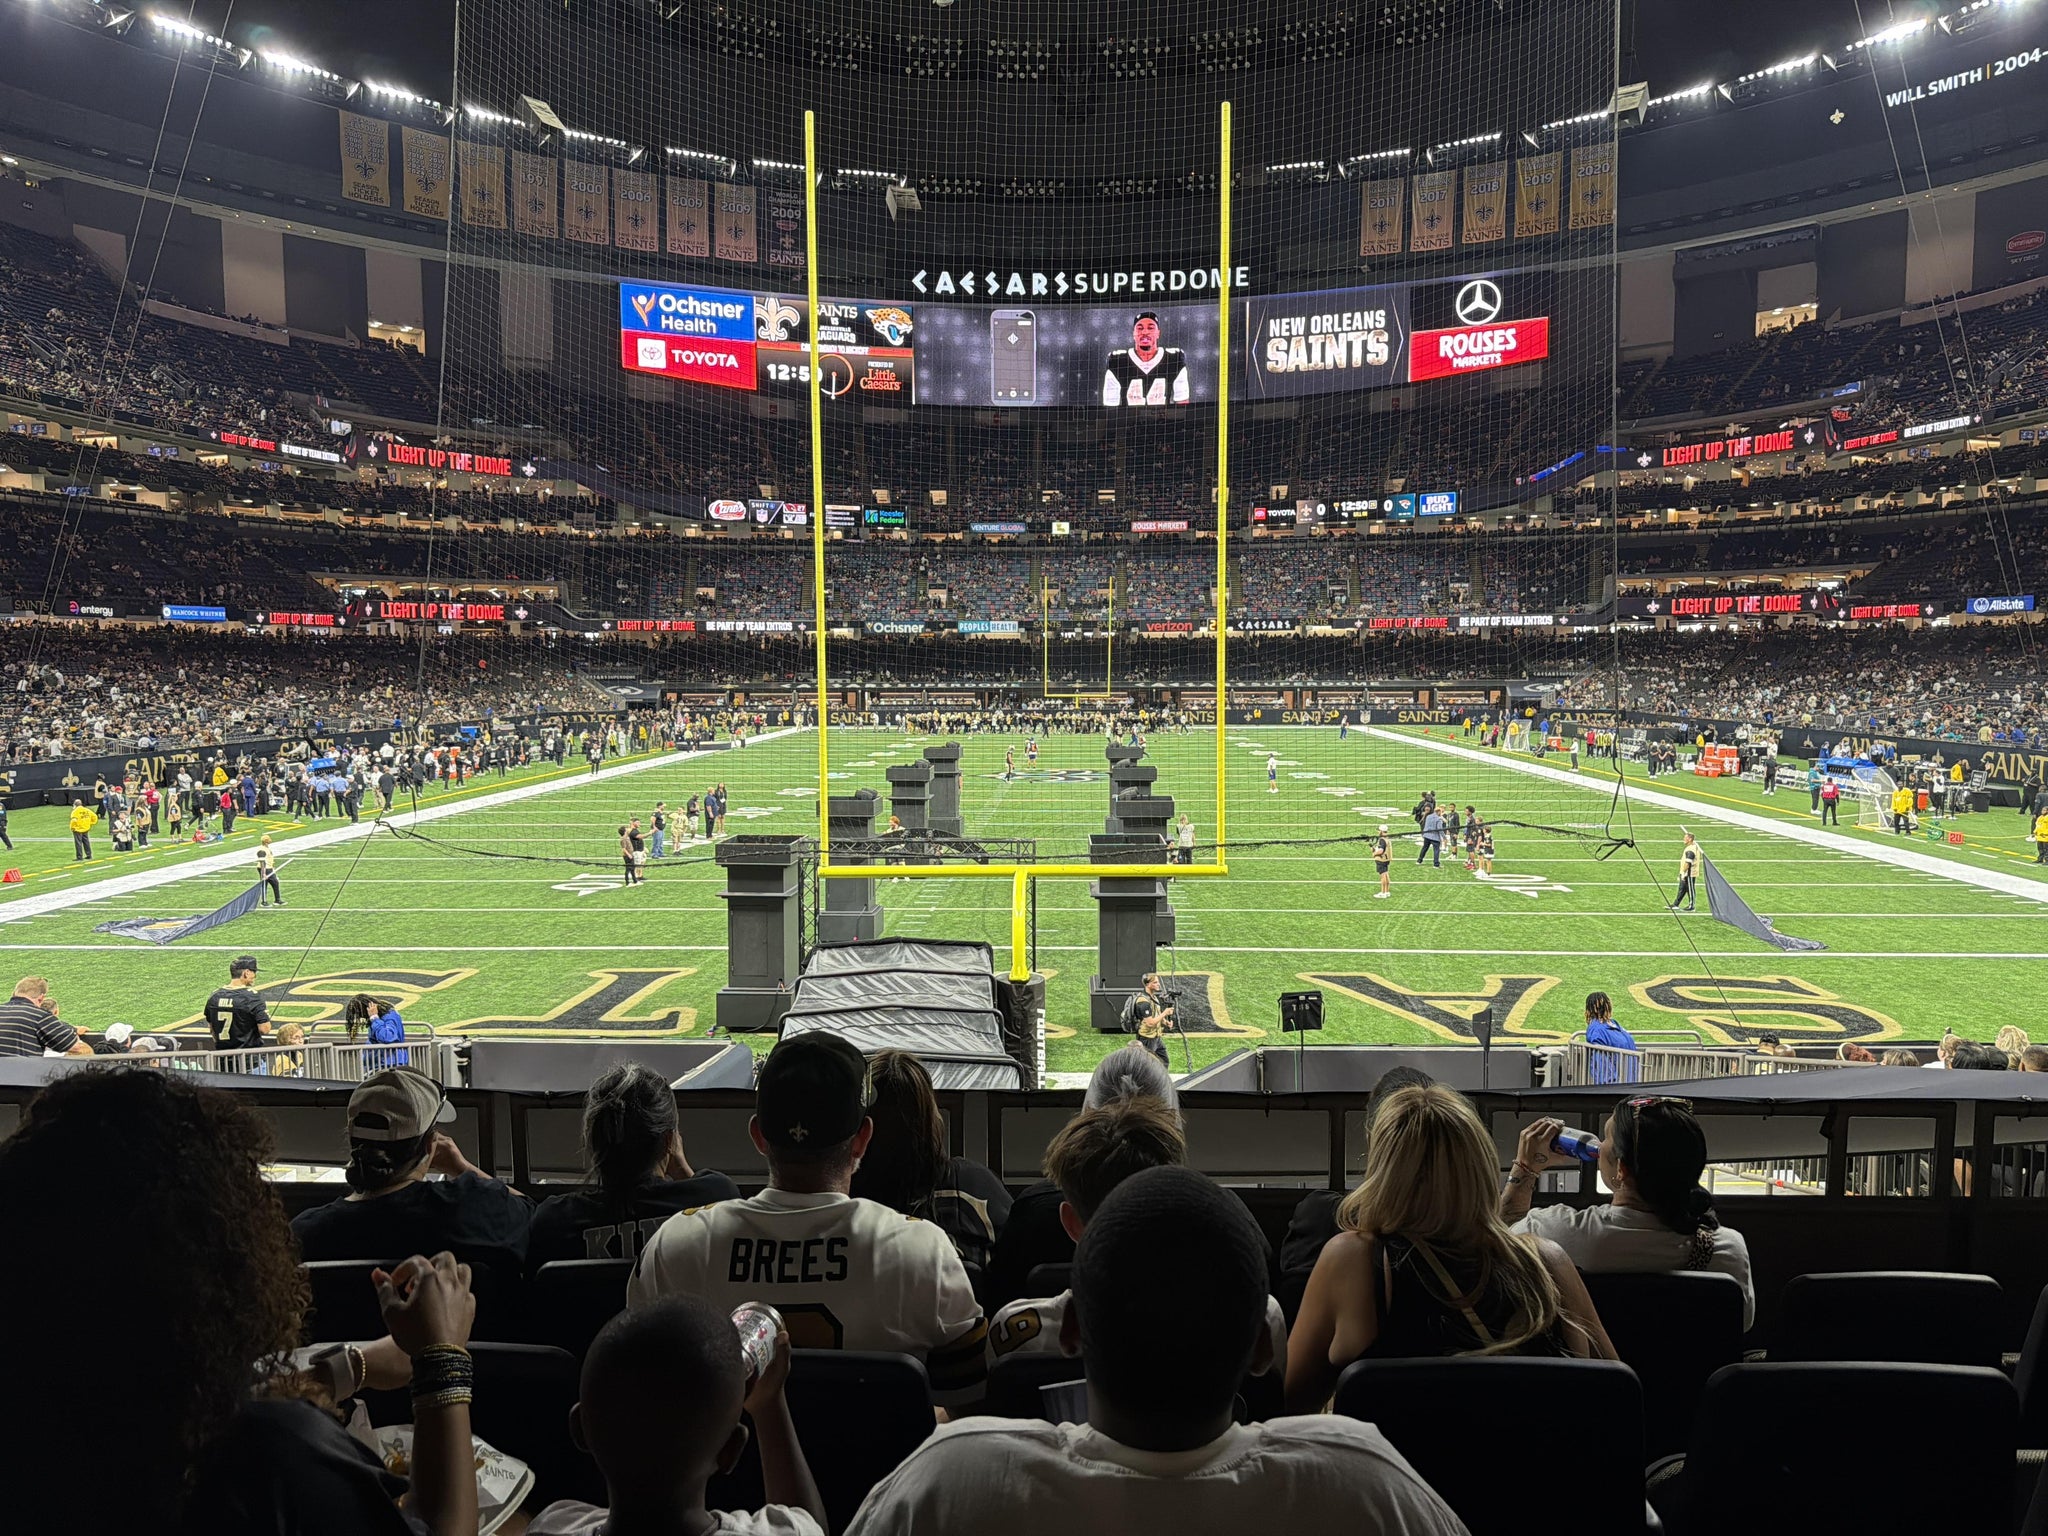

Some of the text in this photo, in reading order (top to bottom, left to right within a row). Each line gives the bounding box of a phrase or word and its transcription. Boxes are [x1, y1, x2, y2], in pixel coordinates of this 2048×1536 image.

[1886, 89, 1926, 108] WILL
[1928, 68, 1982, 96] SMITH
[1577, 162, 1611, 177] 2020
[521, 173, 549, 187] 1991
[1524, 172, 1554, 187] 2019
[571, 179, 603, 195] 2000
[1470, 181, 1499, 195] 2018
[349, 191, 384, 204] HOLDERS
[620, 188, 652, 203] 2006
[672, 195, 703, 208] 2009
[1420, 190, 1448, 203] 2017
[720, 201, 752, 214] 2009
[1370, 196, 1396, 209] 2011
[410, 205, 444, 218] HOLDERS
[771, 206, 802, 219] 2009
[1572, 213, 1612, 228] SAINTS
[517, 222, 555, 237] SAINTS
[1465, 228, 1503, 242] SAINTS
[1517, 221, 1556, 236] SAINTS
[568, 229, 606, 243] SAINTS
[617, 236, 655, 250] SAINTS
[670, 242, 705, 255] SAINTS
[1363, 244, 1399, 255] SAINTS
[1413, 239, 1450, 249] SAINTS
[718, 248, 754, 260] SAINTS
[769, 253, 805, 265] SAINTS
[912, 265, 1250, 296] CAESARS SUPERDOME
[658, 294, 745, 320] Ochsner
[661, 314, 717, 335] Health
[1269, 310, 1386, 338] NEW ORLEANS
[1439, 328, 1517, 359] ROUSES
[1266, 330, 1389, 373] SAINTS
[671, 349, 739, 369] TOYOTA
[1452, 352, 1502, 368] MARKETS
[868, 368, 896, 380] Little
[860, 377, 901, 390] Caesars
[5, 385, 42, 402] SAINTS
[1126, 378, 1167, 406] 44
[1904, 428, 1911, 438] BE
[1912, 424, 1925, 436] PART
[1926, 423, 1933, 433] OF
[1934, 420, 1949, 433] TEAM
[221, 432, 276, 451] LIGHT UP THE DOME
[1844, 431, 1898, 449] LIGHT UP THE DOME
[1662, 430, 1795, 467] LIGHT UP THE DOME
[387, 443, 512, 477] LIGHT UP THE DOME
[1341, 500, 1368, 511] 12:50
[1383, 499, 1393, 512] 0
[1425, 495, 1450, 505] BUD
[879, 510, 905, 518] Keesler
[1267, 509, 1296, 517] TOYOTA
[1316, 503, 1326, 516] 0
[1422, 503, 1453, 514] LIGHT
[1132, 521, 1188, 531] ROUSES MARKETS
[14, 600, 49, 612] SAINTS
[81, 605, 113, 617] entergy
[380, 602, 504, 620] LIGHT UP THE DOME
[1671, 594, 1802, 615] LIGHT UP THE DOME
[1989, 599, 2025, 611] Allstate
[172, 609, 198, 617] HANCOCK
[1850, 604, 1920, 619] LIGHT UP THE DOME
[269, 612, 334, 626] LIGHT UP THE DOME
[1238, 620, 1291, 630] CAESARS
[1369, 617, 1448, 628] LIGHT UP THE DOME
[1459, 615, 1553, 627] BE PART OF TEAM INTROS
[617, 621, 695, 631] LIGHT UP THE DOME
[706, 621, 793, 631] BE PART OF TEAM INTROS
[873, 621, 924, 634] Ochsner
[959, 621, 1018, 632] PEOPLES HEALTH
[1146, 621, 1193, 632] verizon
[1398, 710, 1450, 724] SAINTS
[1950, 833, 1962, 843] 20
[218, 998, 234, 1008] HILL
[217, 1011, 233, 1041] 7
[728, 1237, 848, 1283] BREES
[485, 1465, 516, 1481] SAINTS
